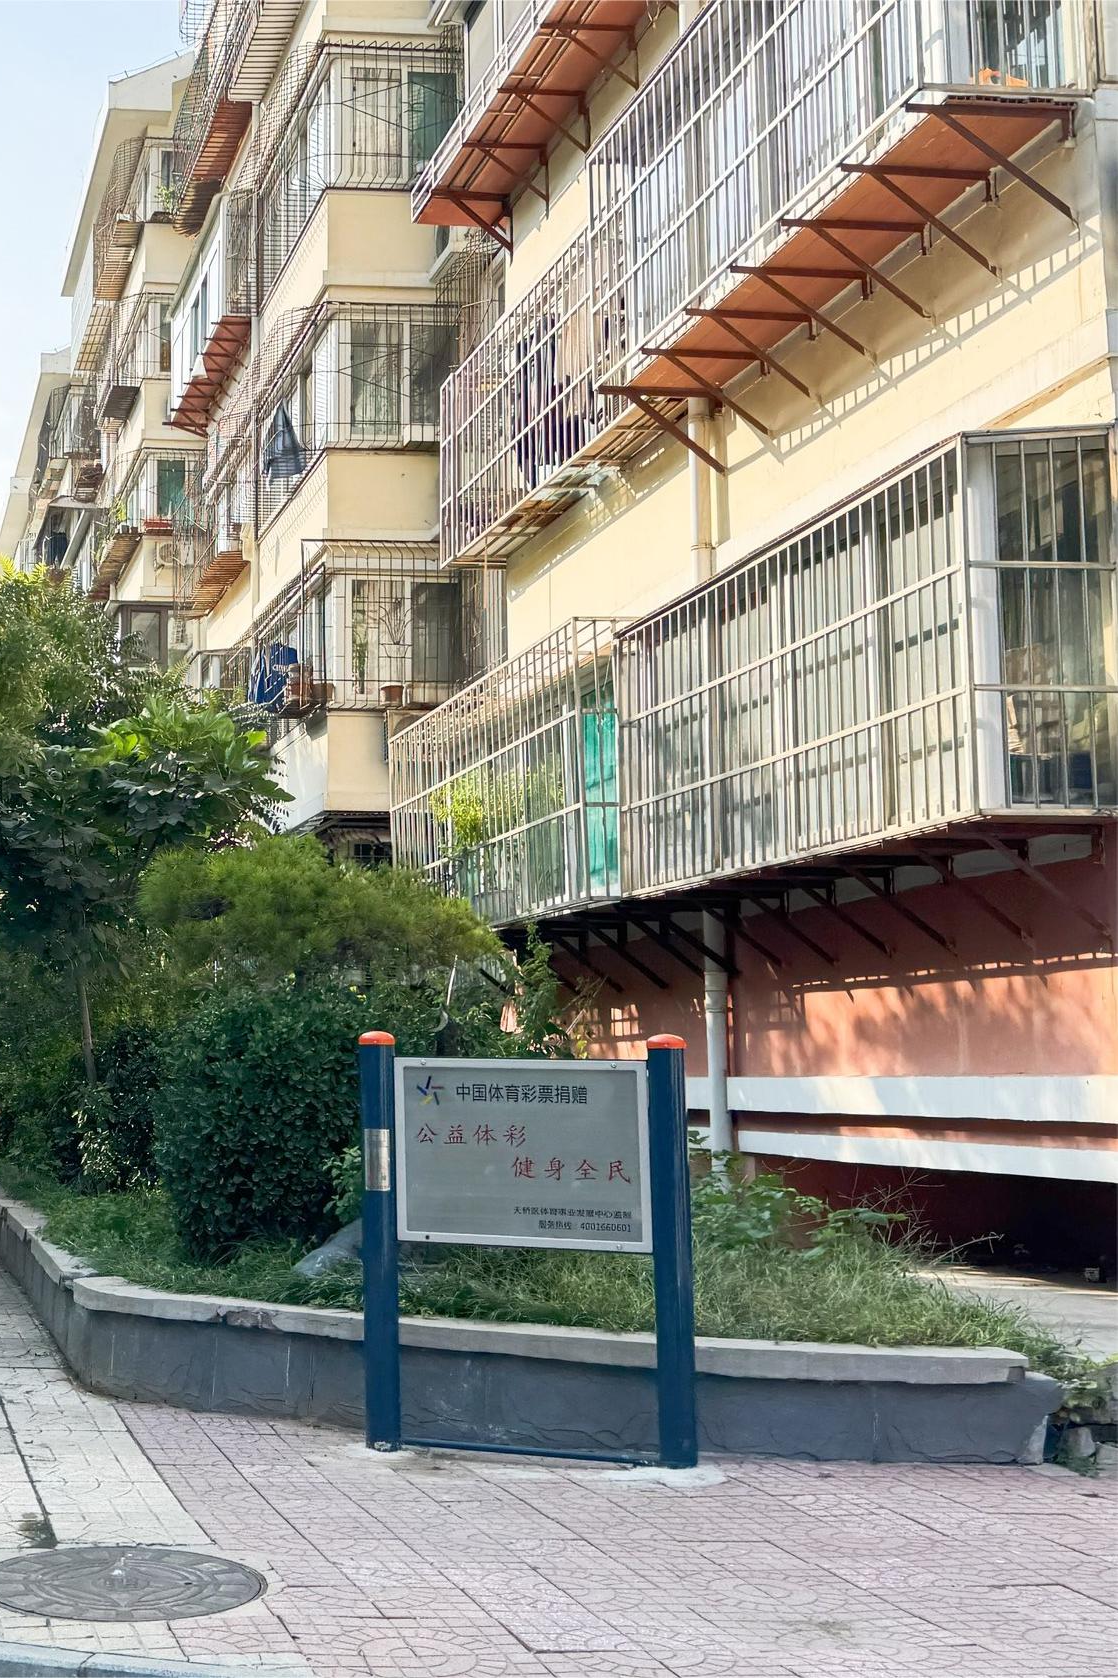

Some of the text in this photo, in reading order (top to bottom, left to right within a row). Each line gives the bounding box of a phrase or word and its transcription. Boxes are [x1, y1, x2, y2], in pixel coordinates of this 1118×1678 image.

[456, 1083, 588, 1105] 中国体育彩票捐赠
[417, 1124, 527, 1148] 公益体彩
[511, 1157, 631, 1184] 健身全民
